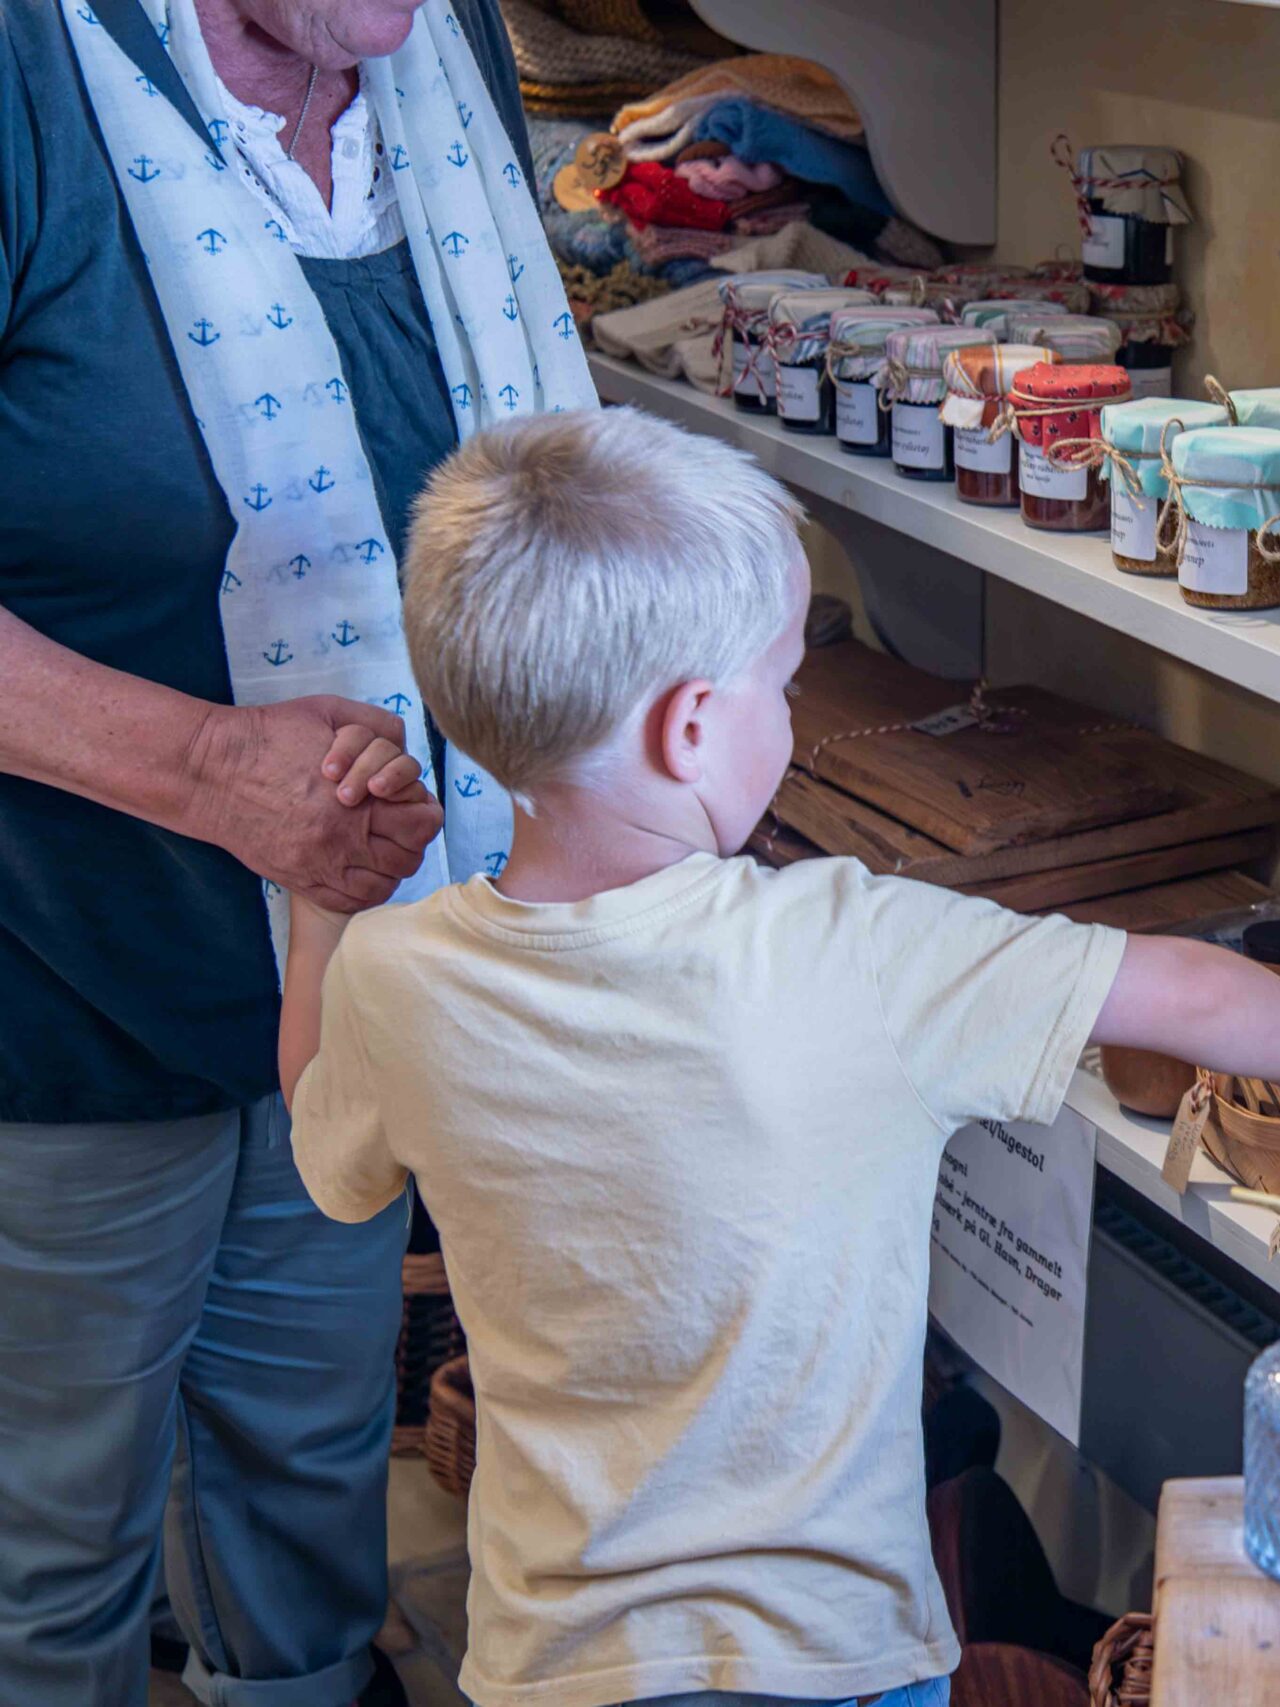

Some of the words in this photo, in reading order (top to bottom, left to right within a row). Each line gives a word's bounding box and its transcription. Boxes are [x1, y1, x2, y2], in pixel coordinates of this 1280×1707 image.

[963, 1218, 976, 1237] på
[994, 1240, 1022, 1275] Havn,
[1025, 1264, 1063, 1302] Dragør
[997, 1219, 1014, 1243] fra
[1017, 1236, 1062, 1279] gammelt
